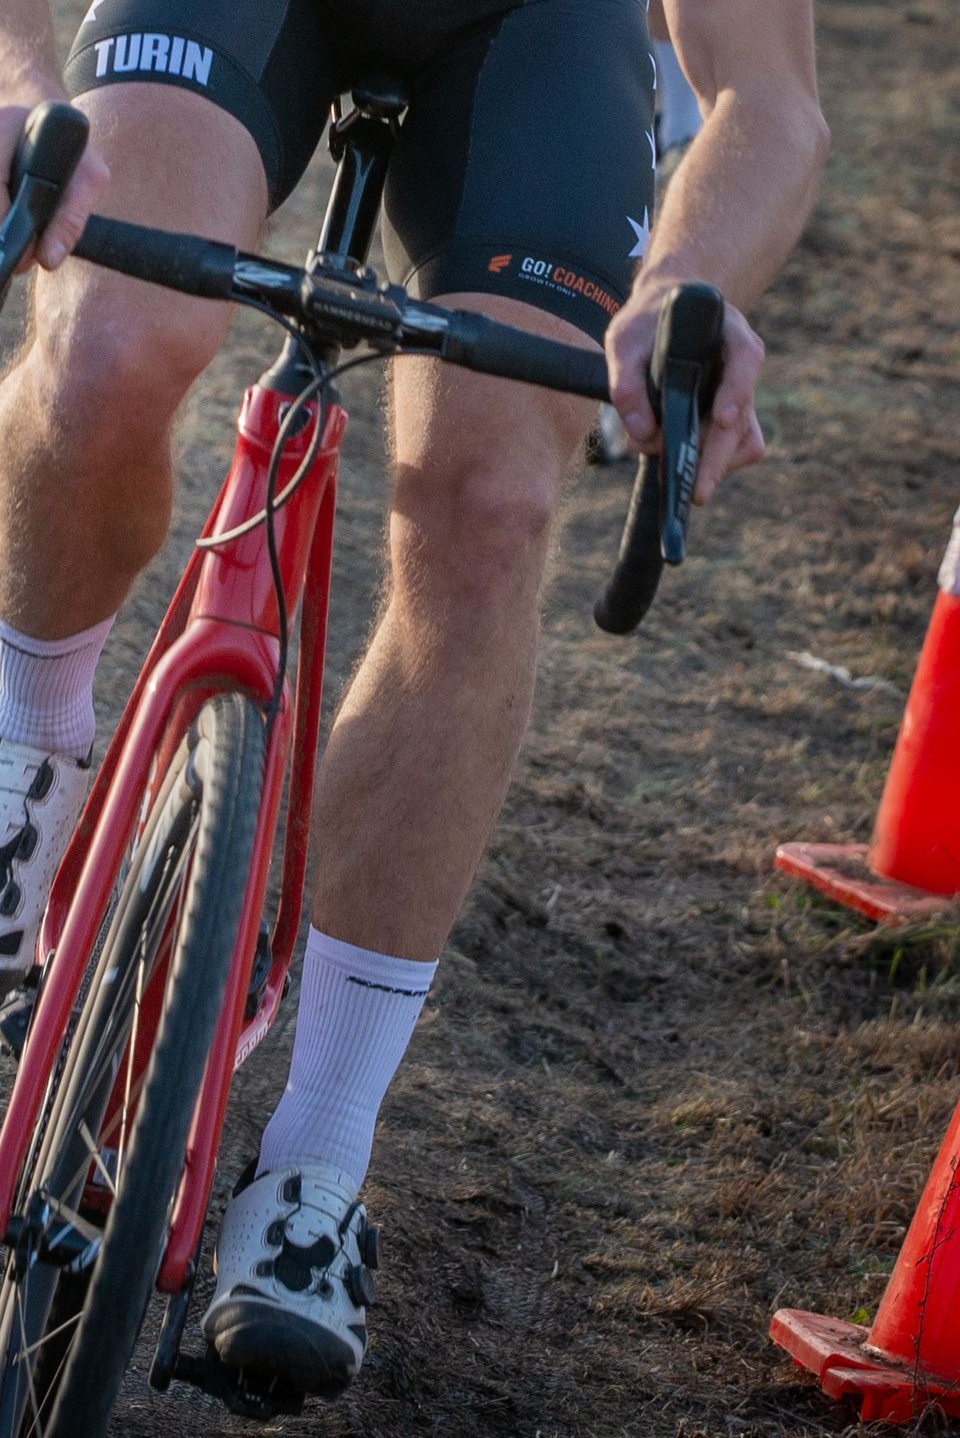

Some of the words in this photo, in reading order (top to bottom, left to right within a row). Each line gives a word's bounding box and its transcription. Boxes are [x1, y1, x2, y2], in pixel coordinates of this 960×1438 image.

[94, 32, 213, 87] TURIN
[521, 257, 553, 278] GO!
[552, 266, 622, 317] COACHING
